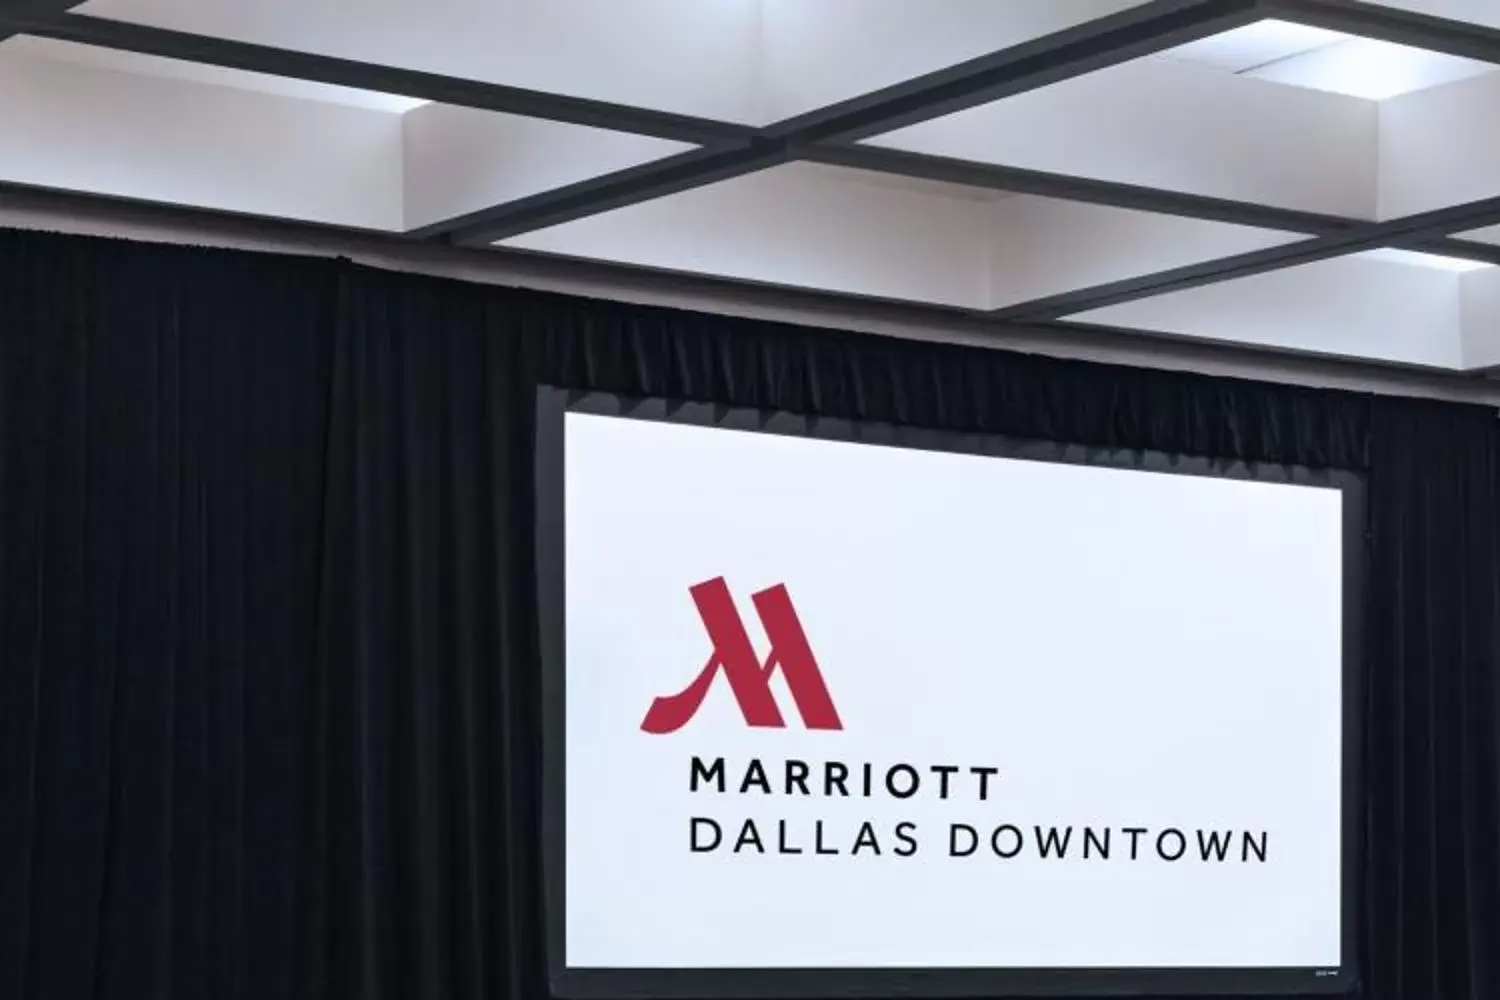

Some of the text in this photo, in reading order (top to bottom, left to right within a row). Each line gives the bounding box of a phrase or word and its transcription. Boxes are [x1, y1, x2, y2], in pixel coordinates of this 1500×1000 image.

[689, 755, 1000, 801] MARRIOTT
[689, 816, 1269, 863] DALLAS DOWNTOWN
